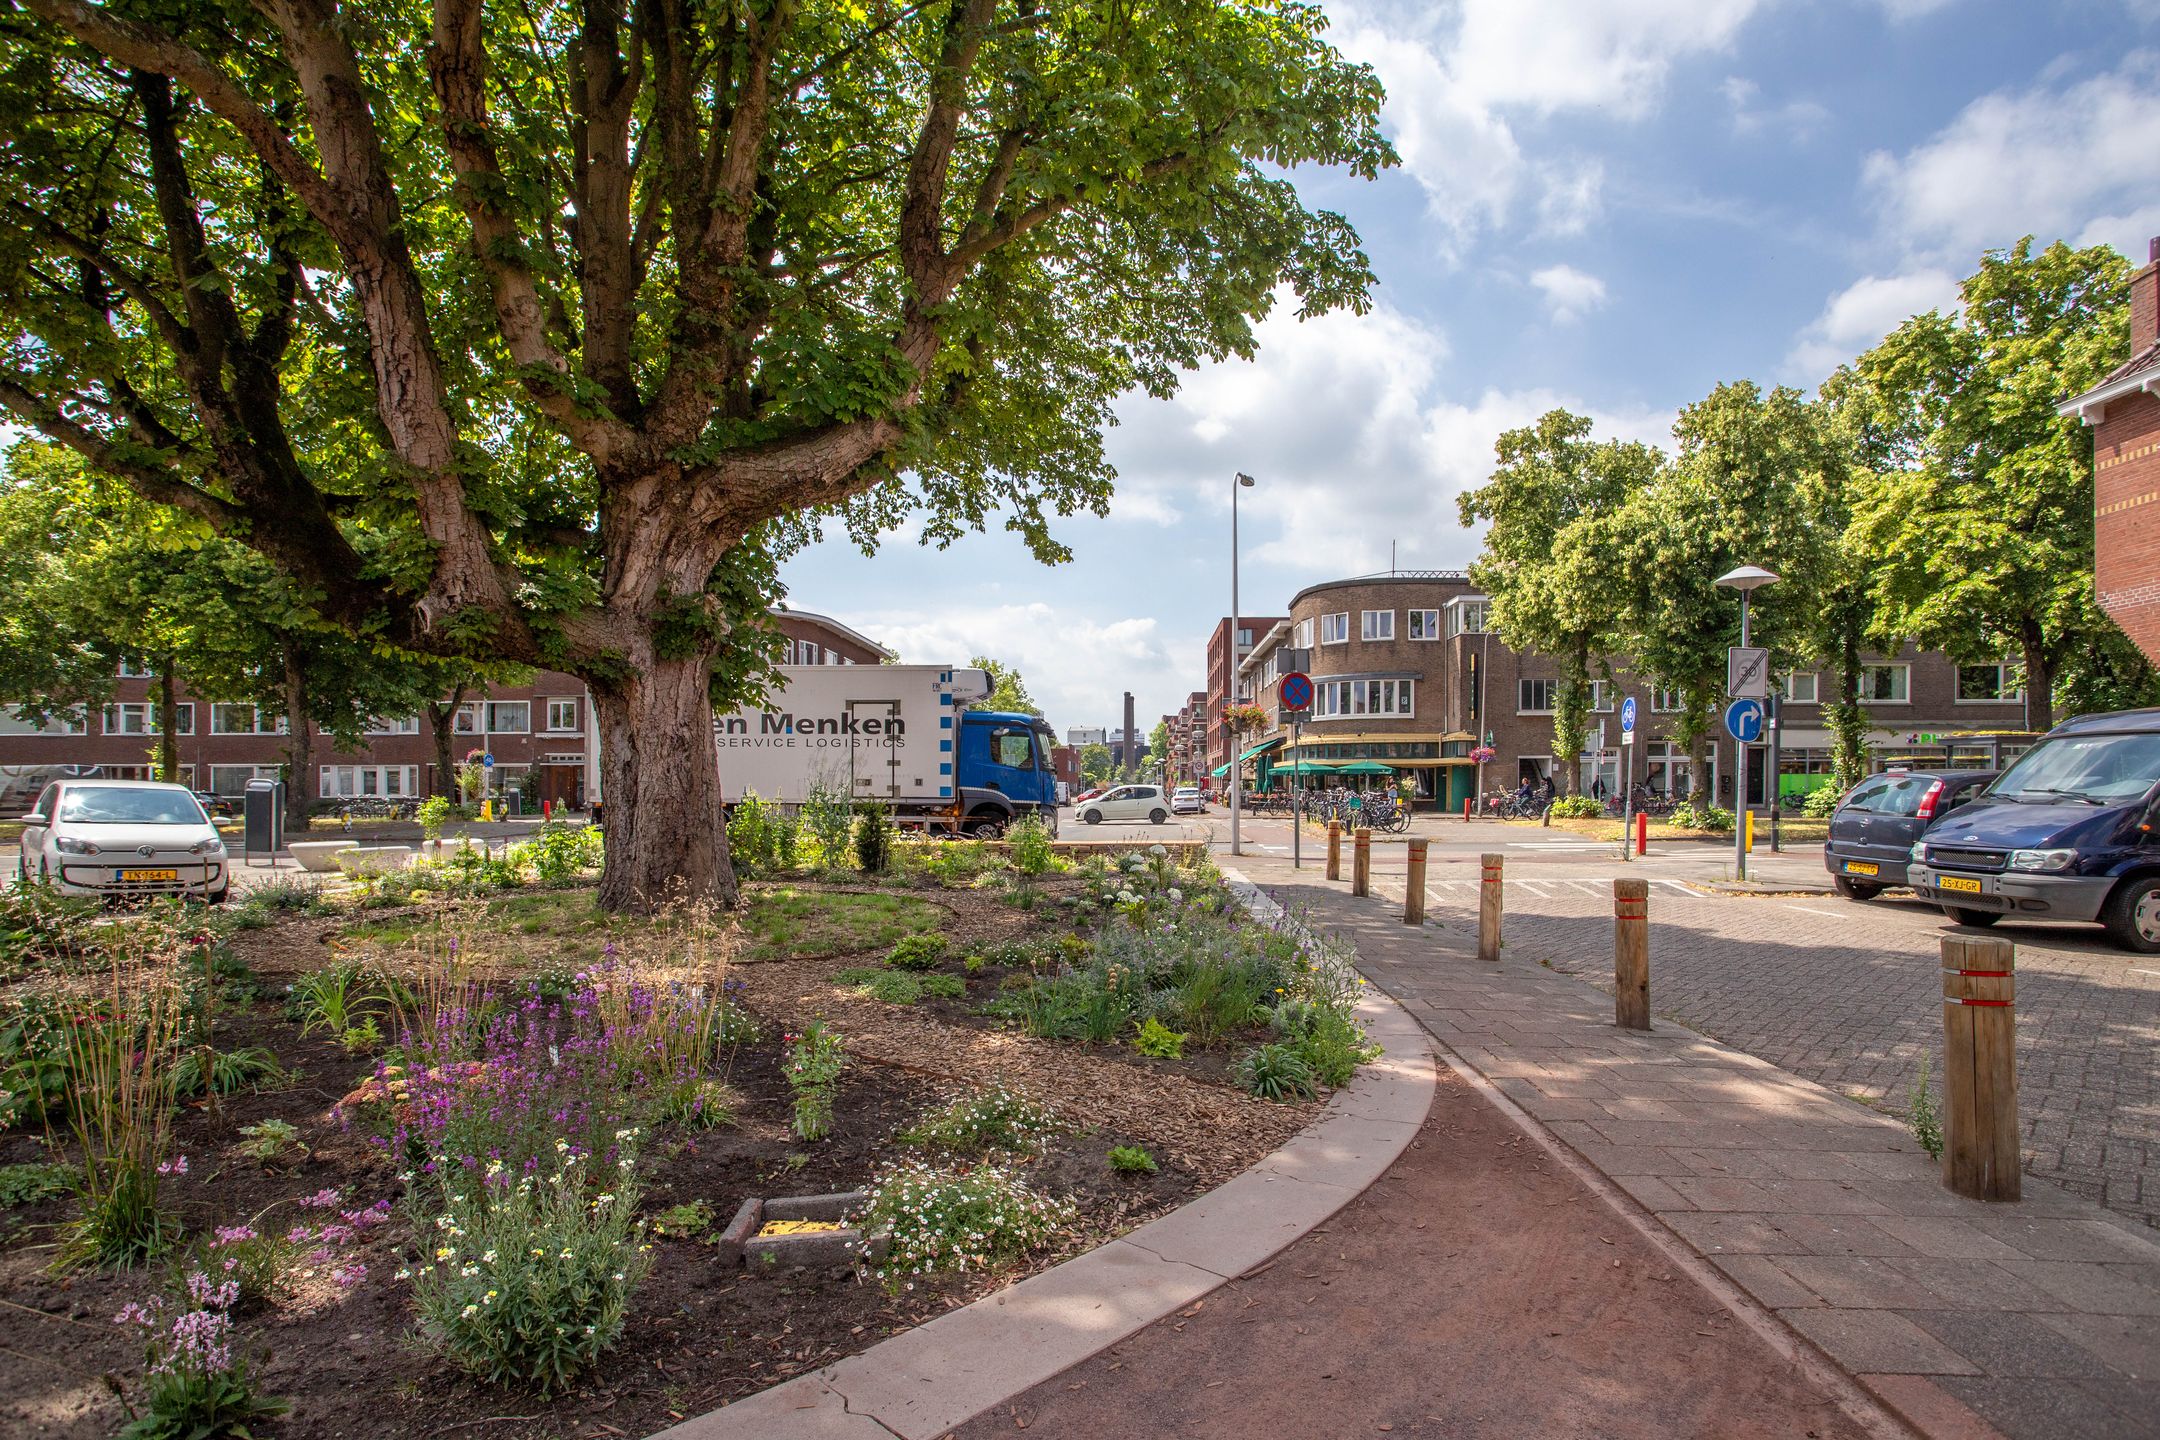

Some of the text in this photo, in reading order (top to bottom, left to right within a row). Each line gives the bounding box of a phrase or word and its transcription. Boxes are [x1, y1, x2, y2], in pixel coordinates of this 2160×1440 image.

[761, 712, 905, 735] Menken
[717, 738, 906, 748] SERVICE LOGISTICS
